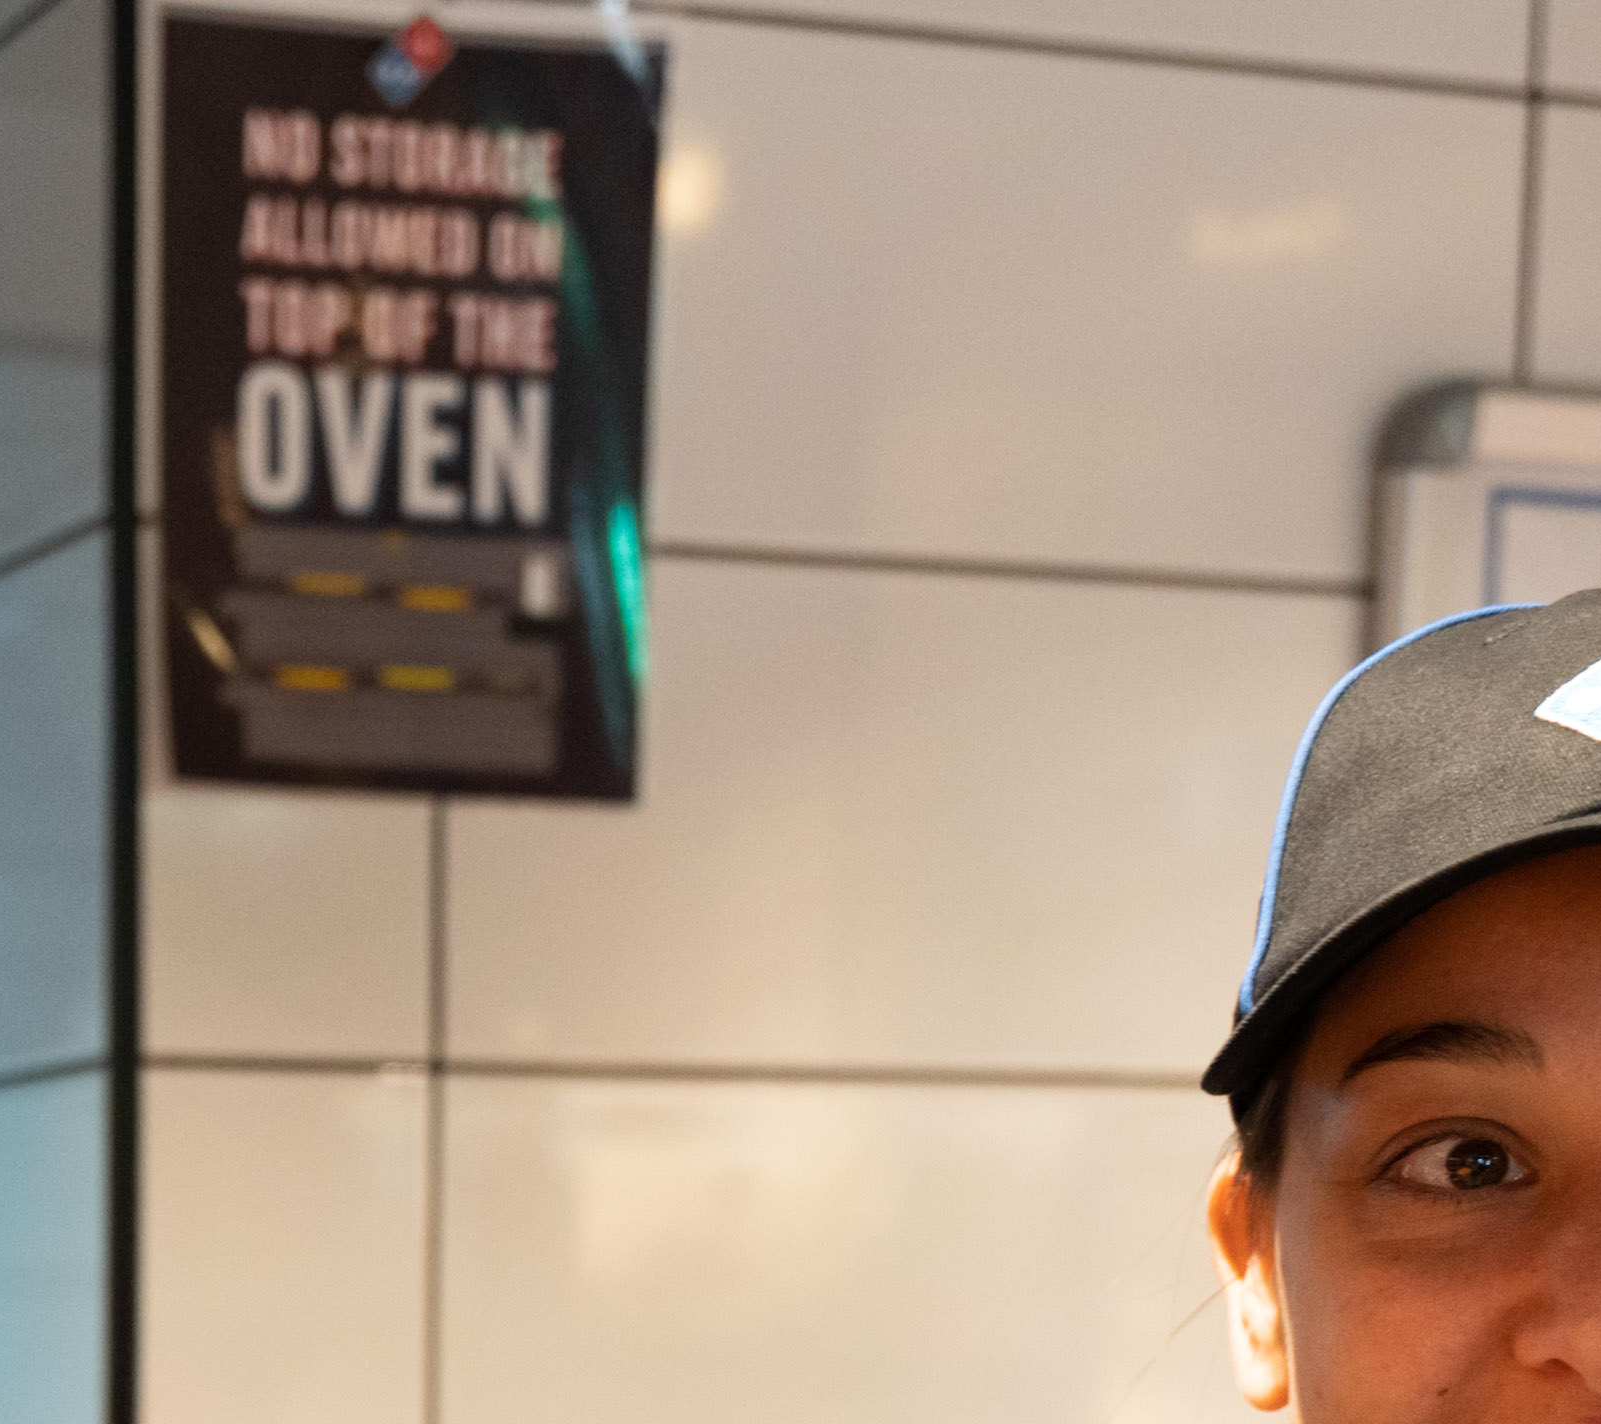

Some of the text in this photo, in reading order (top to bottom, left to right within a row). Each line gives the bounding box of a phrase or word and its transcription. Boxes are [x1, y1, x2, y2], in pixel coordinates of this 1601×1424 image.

[242, 106, 320, 185] NO
[240, 193, 562, 282] ALLOWED ON
[240, 276, 558, 372] TOP OF THE
[236, 360, 554, 524] OVEN
